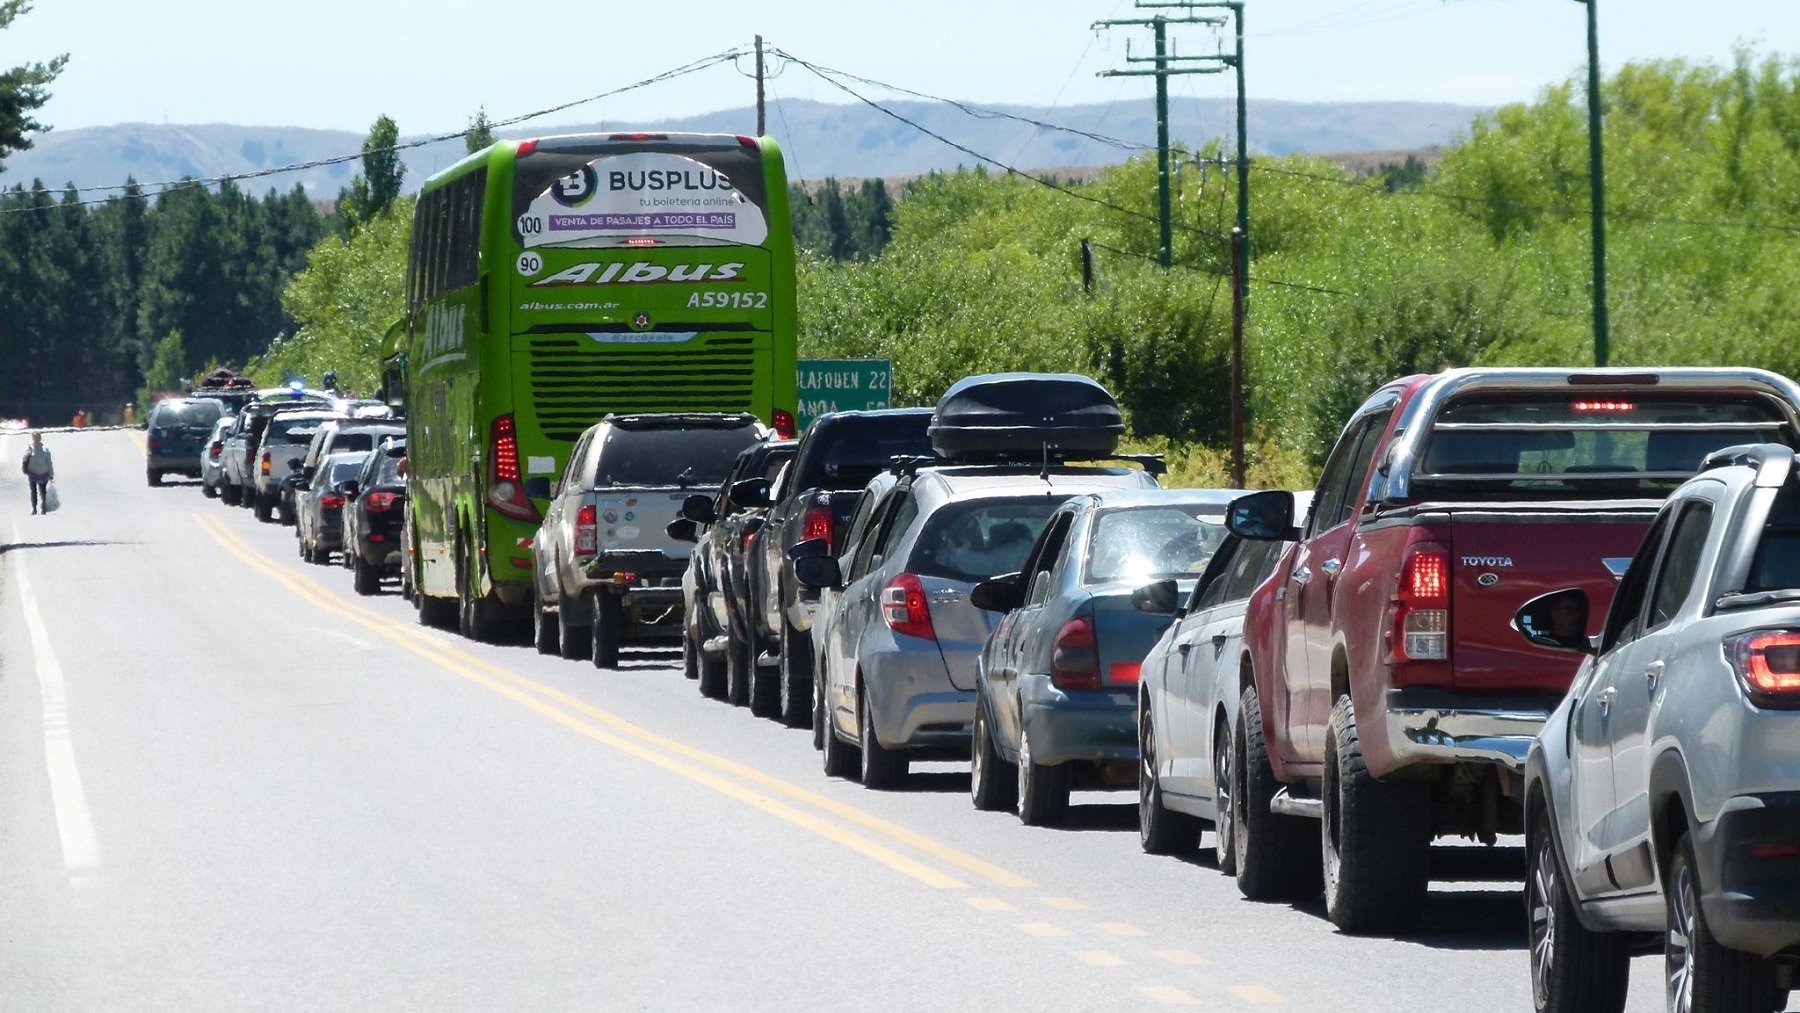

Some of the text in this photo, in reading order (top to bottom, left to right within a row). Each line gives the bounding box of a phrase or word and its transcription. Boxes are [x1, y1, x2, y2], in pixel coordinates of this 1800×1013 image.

[609, 170, 734, 191] BUSPLUS
[640, 198, 651, 206] tu
[702, 197, 734, 206] online
[520, 216, 541, 234] 100
[554, 213, 733, 226] VENTA DE PASAJES A TODO EL PAÍS
[520, 257, 540, 272] 90
[531, 261, 745, 286] Albus
[520, 301, 619, 310] albus.com.ar
[687, 291, 768, 309] A59152
[796, 370, 887, 389] LAFQUEN 22
[1461, 556, 1513, 567] TOYOTA
